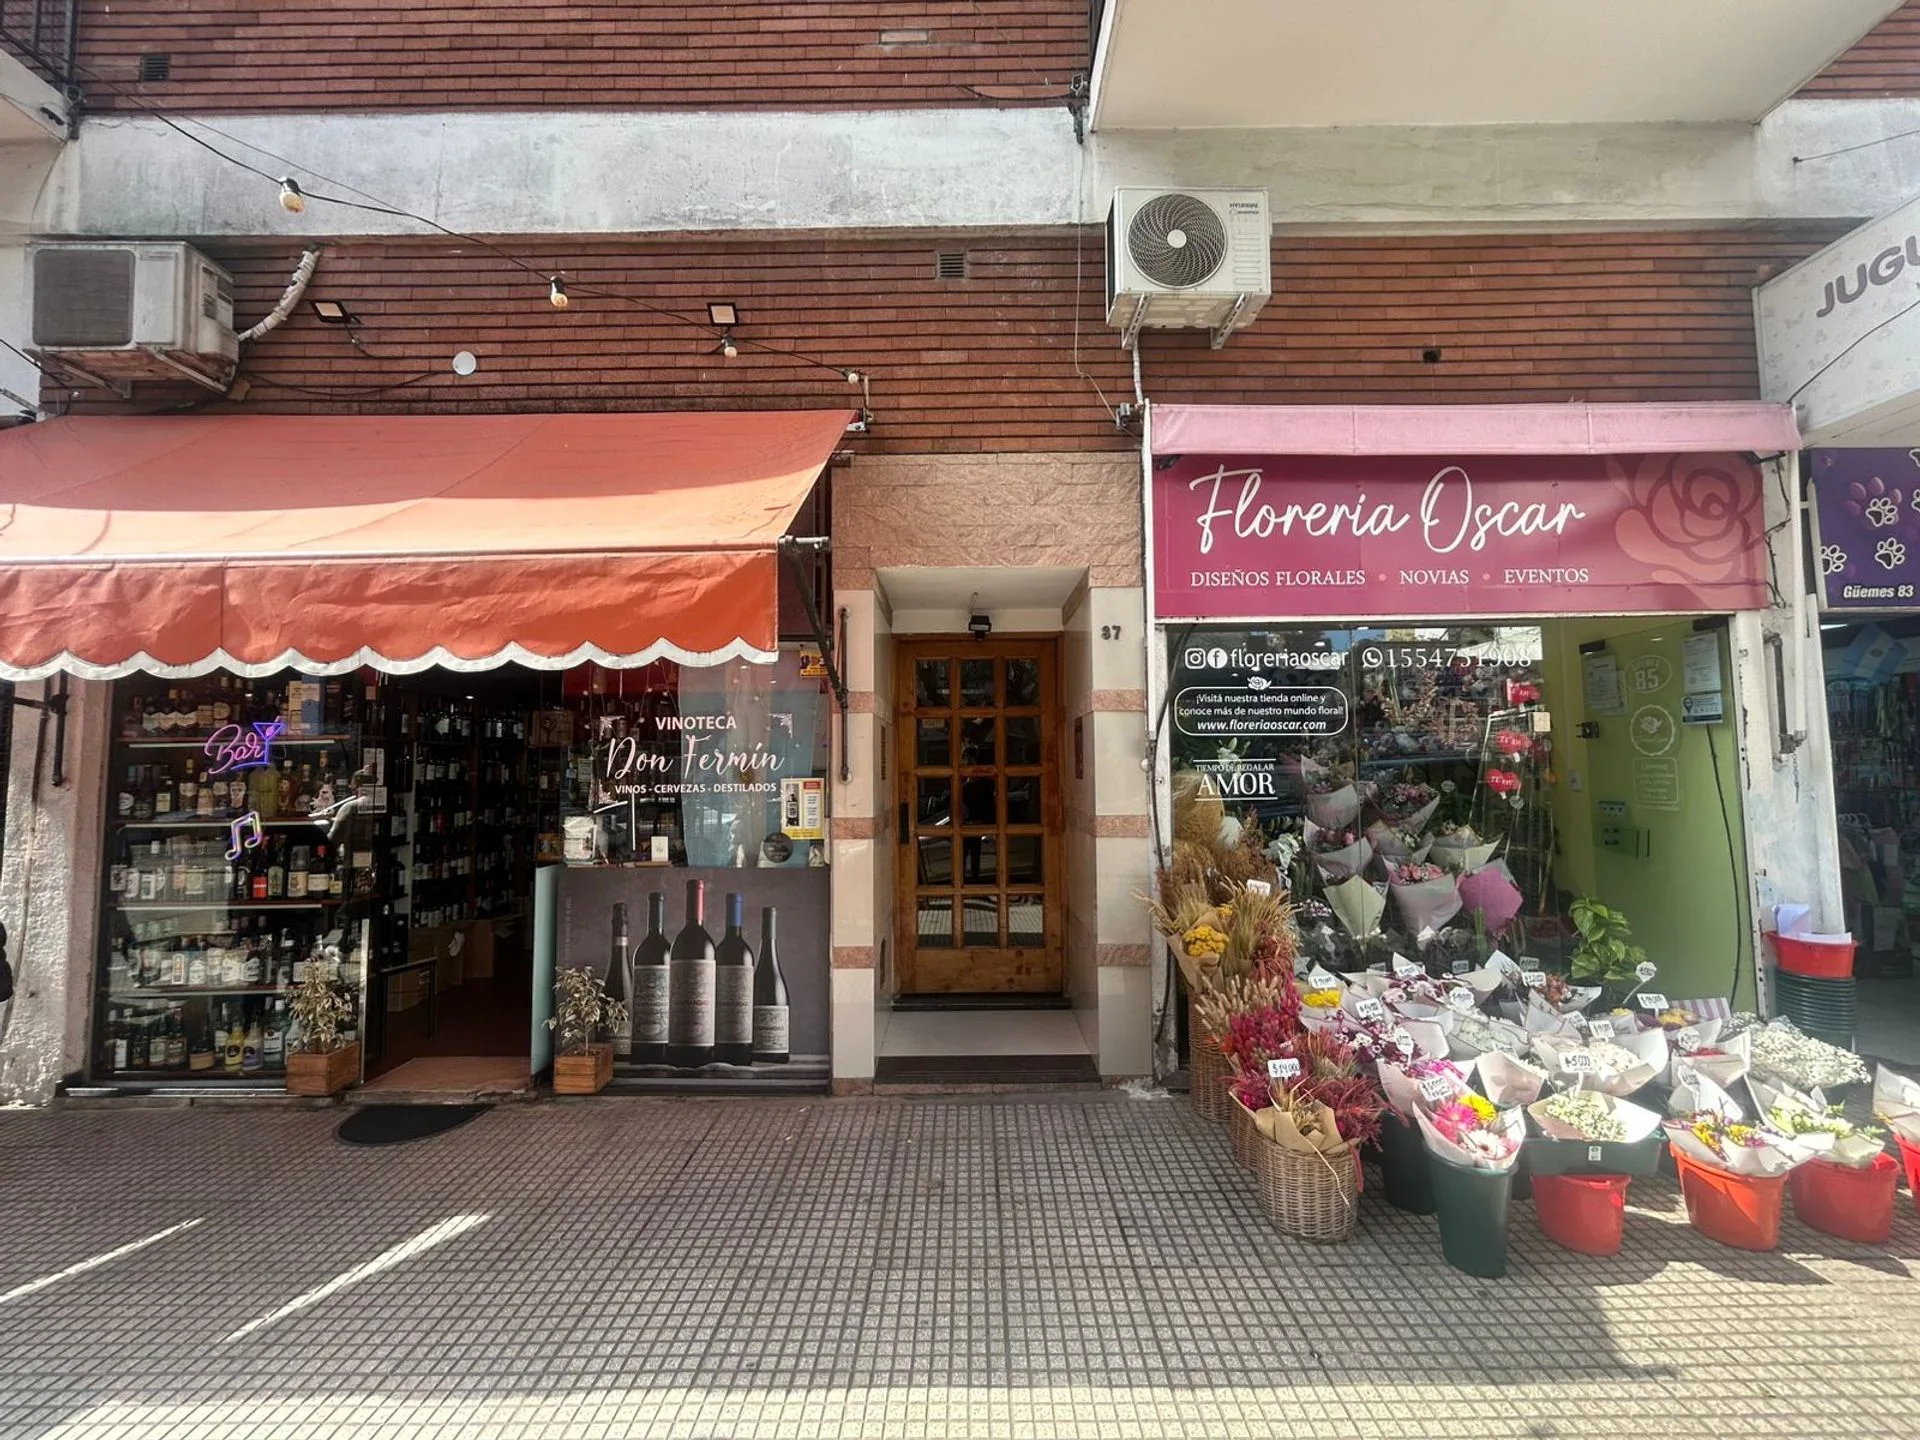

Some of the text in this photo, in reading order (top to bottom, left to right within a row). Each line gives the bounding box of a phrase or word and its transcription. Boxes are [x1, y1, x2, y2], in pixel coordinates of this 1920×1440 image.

[1420, 465, 1586, 554] Oscar
[1190, 567, 1589, 587] DISEÑOS FLORALES NOVIAS EVENTOS
[1843, 584, 1914, 598] Güemes 83
[1100, 624, 1122, 641] 87
[1230, 648, 1349, 667] floreriaoscar
[1634, 667, 1660, 691] 85
[1224, 694, 1258, 703] nuestra
[1259, 693, 1289, 703] tienda
[1290, 693, 1319, 703] online
[1319, 695, 1326, 704] y
[1179, 707, 1212, 716] conoce
[1213, 706, 1233, 715] más
[1233, 706, 1246, 715] de
[1248, 706, 1282, 716] nuestro
[1283, 706, 1317, 715] mundo
[655, 715, 737, 731] VINOTECA
[1197, 718, 1326, 731] www.floreriaoscar.com
[203, 723, 265, 775] Bar
[605, 736, 674, 781] Don
[615, 782, 777, 795] VINOS CERVEZAS DESTILADOS
[1196, 772, 1276, 796] AMOR
